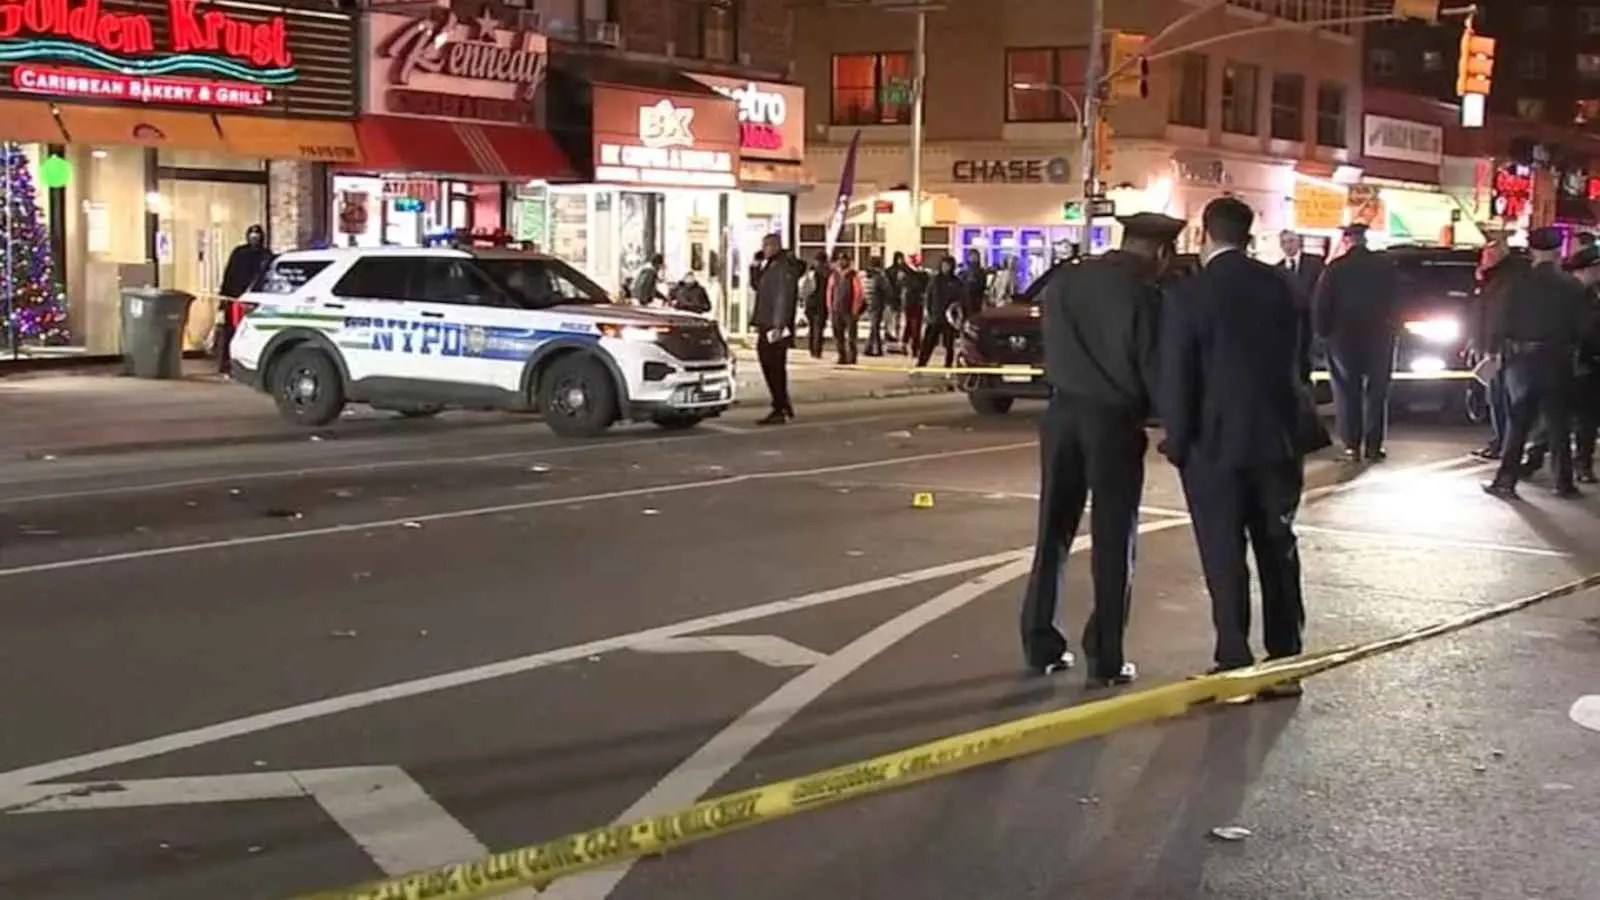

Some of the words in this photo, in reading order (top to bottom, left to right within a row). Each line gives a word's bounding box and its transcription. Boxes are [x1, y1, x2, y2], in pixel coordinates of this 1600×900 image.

[168, 0, 292, 67] Krust
[376, 14, 547, 100] Kennedy
[20, 69, 124, 95] CARIBBEAN
[129, 80, 194, 101] BAKERY
[198, 86, 210, 101] &
[215, 87, 263, 104] GRILL
[712, 81, 786, 126] etro
[952, 160, 1042, 183] CHASE
[371, 322, 461, 356] NYPD
